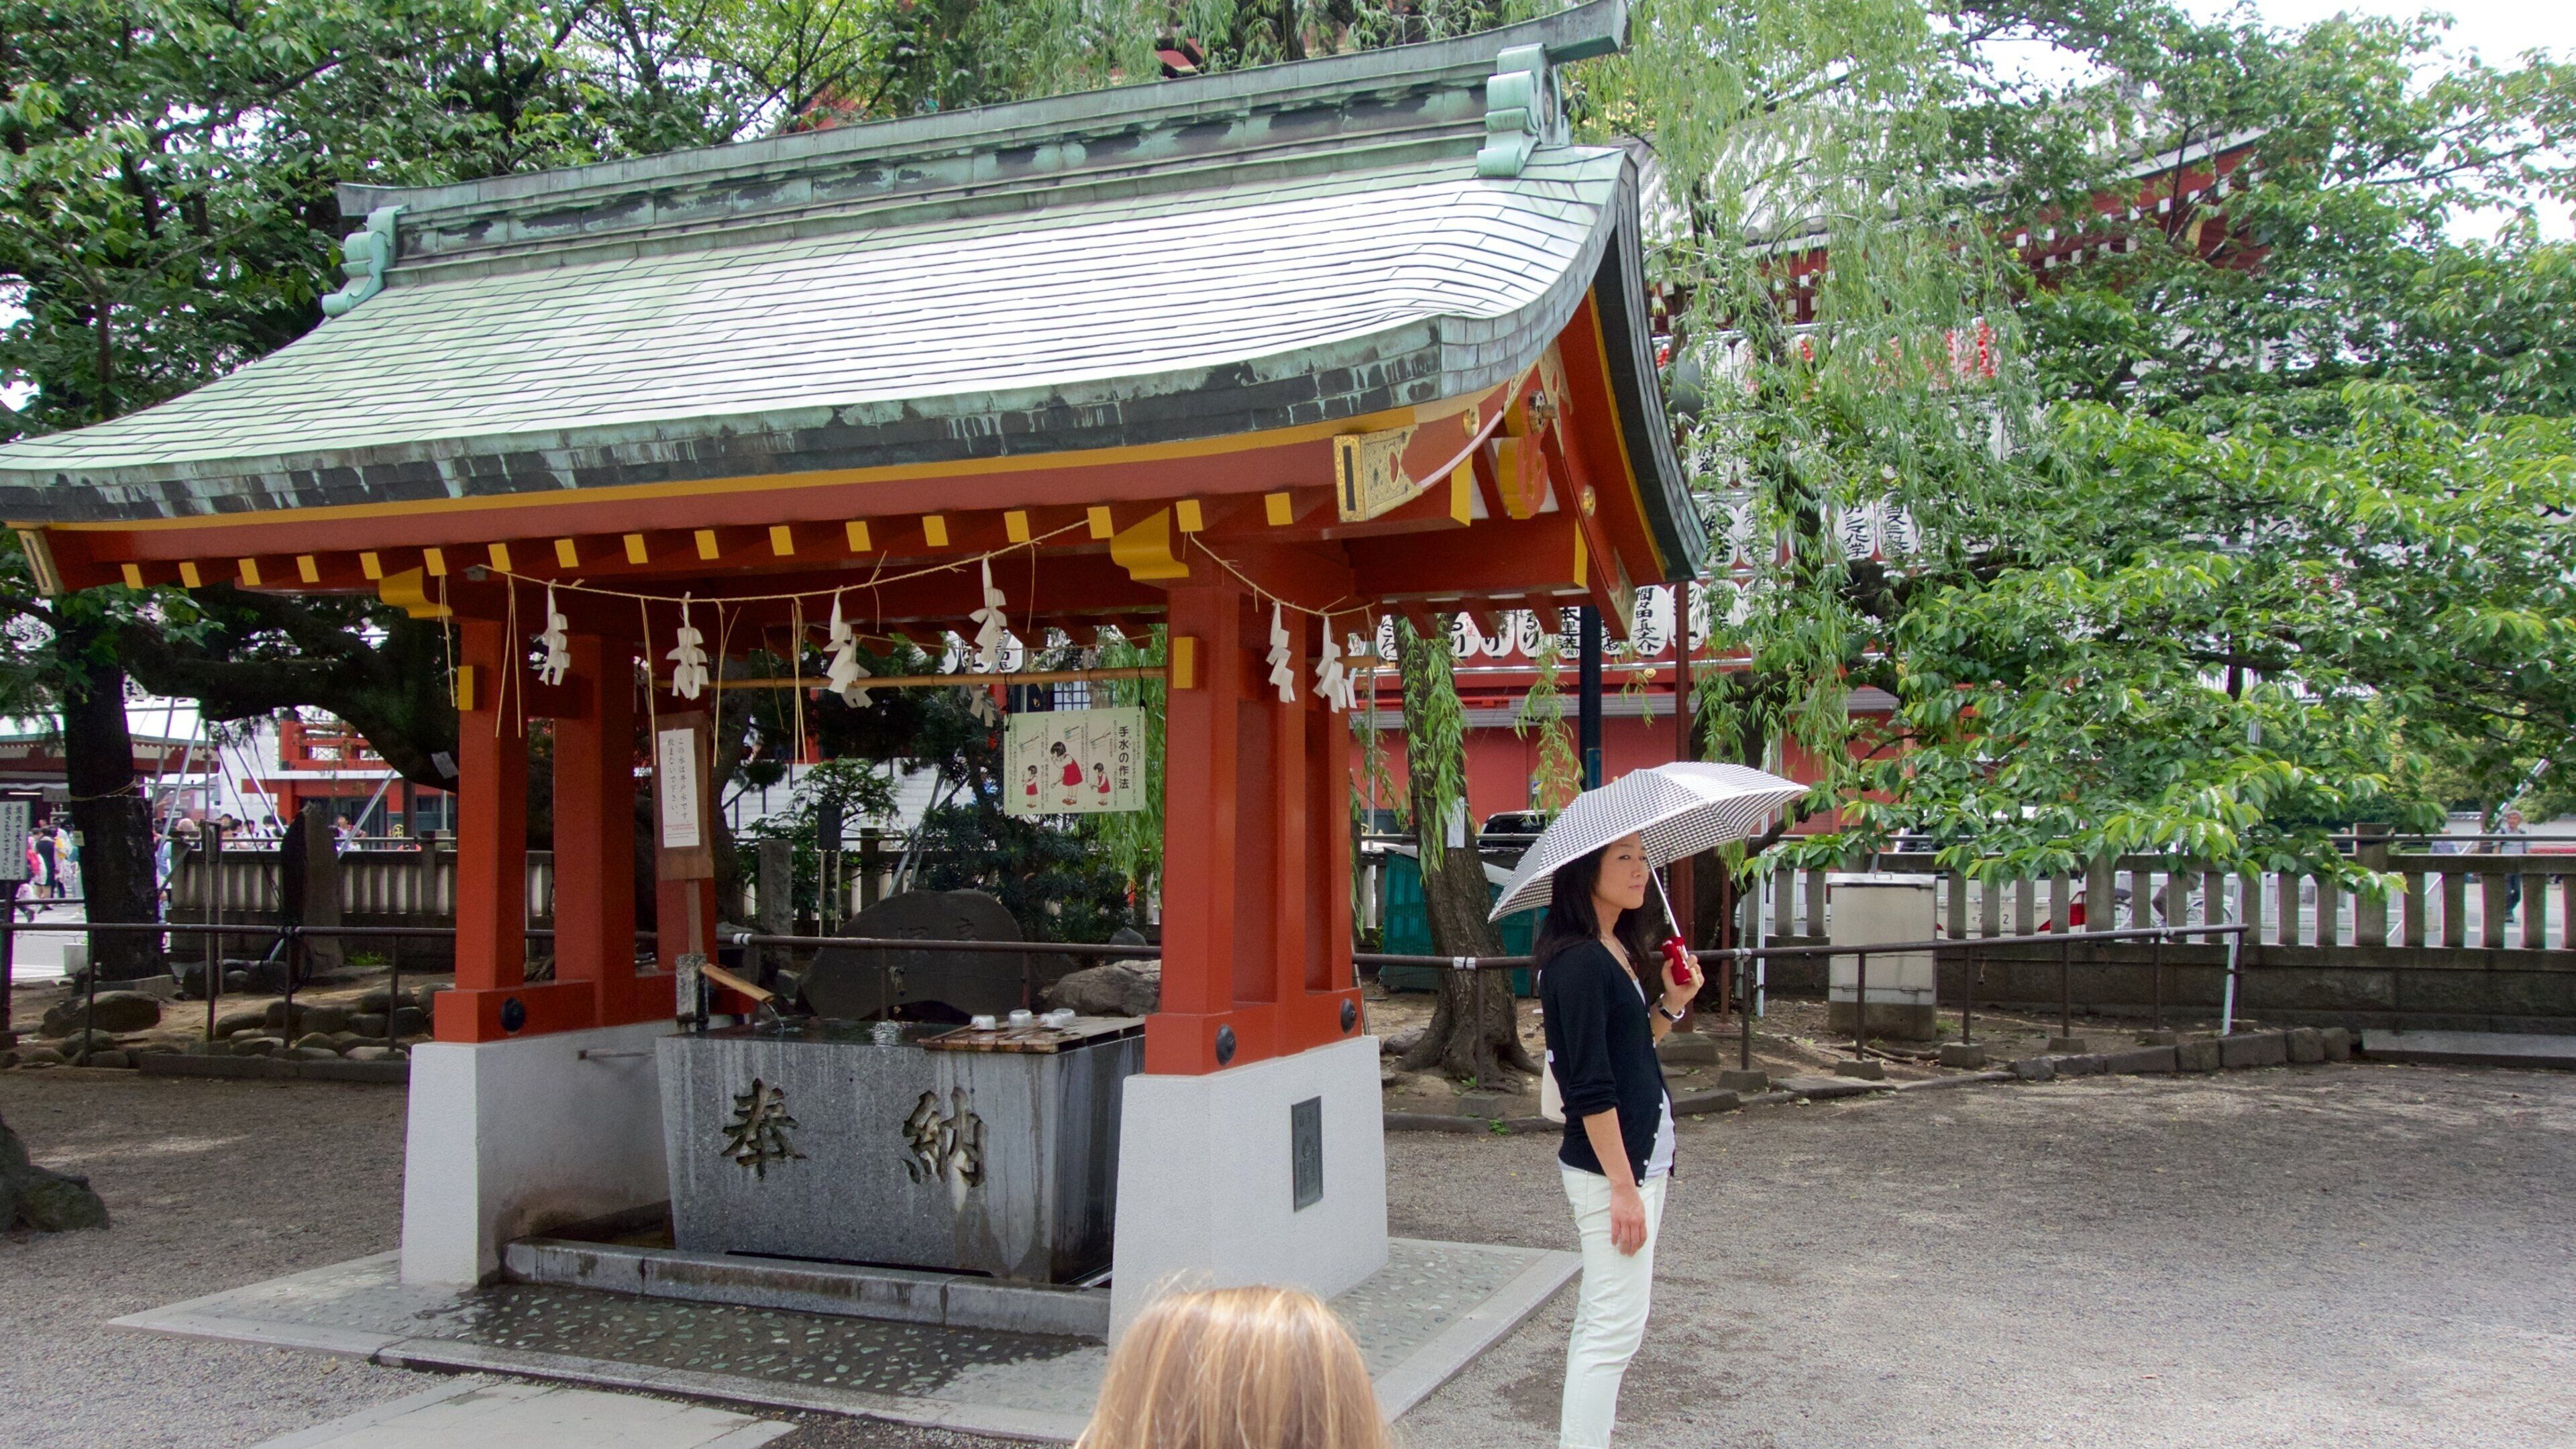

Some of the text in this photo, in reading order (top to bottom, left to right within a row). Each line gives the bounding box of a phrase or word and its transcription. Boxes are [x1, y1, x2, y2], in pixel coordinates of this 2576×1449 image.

[1118, 726, 1129, 790] 手水の作法
